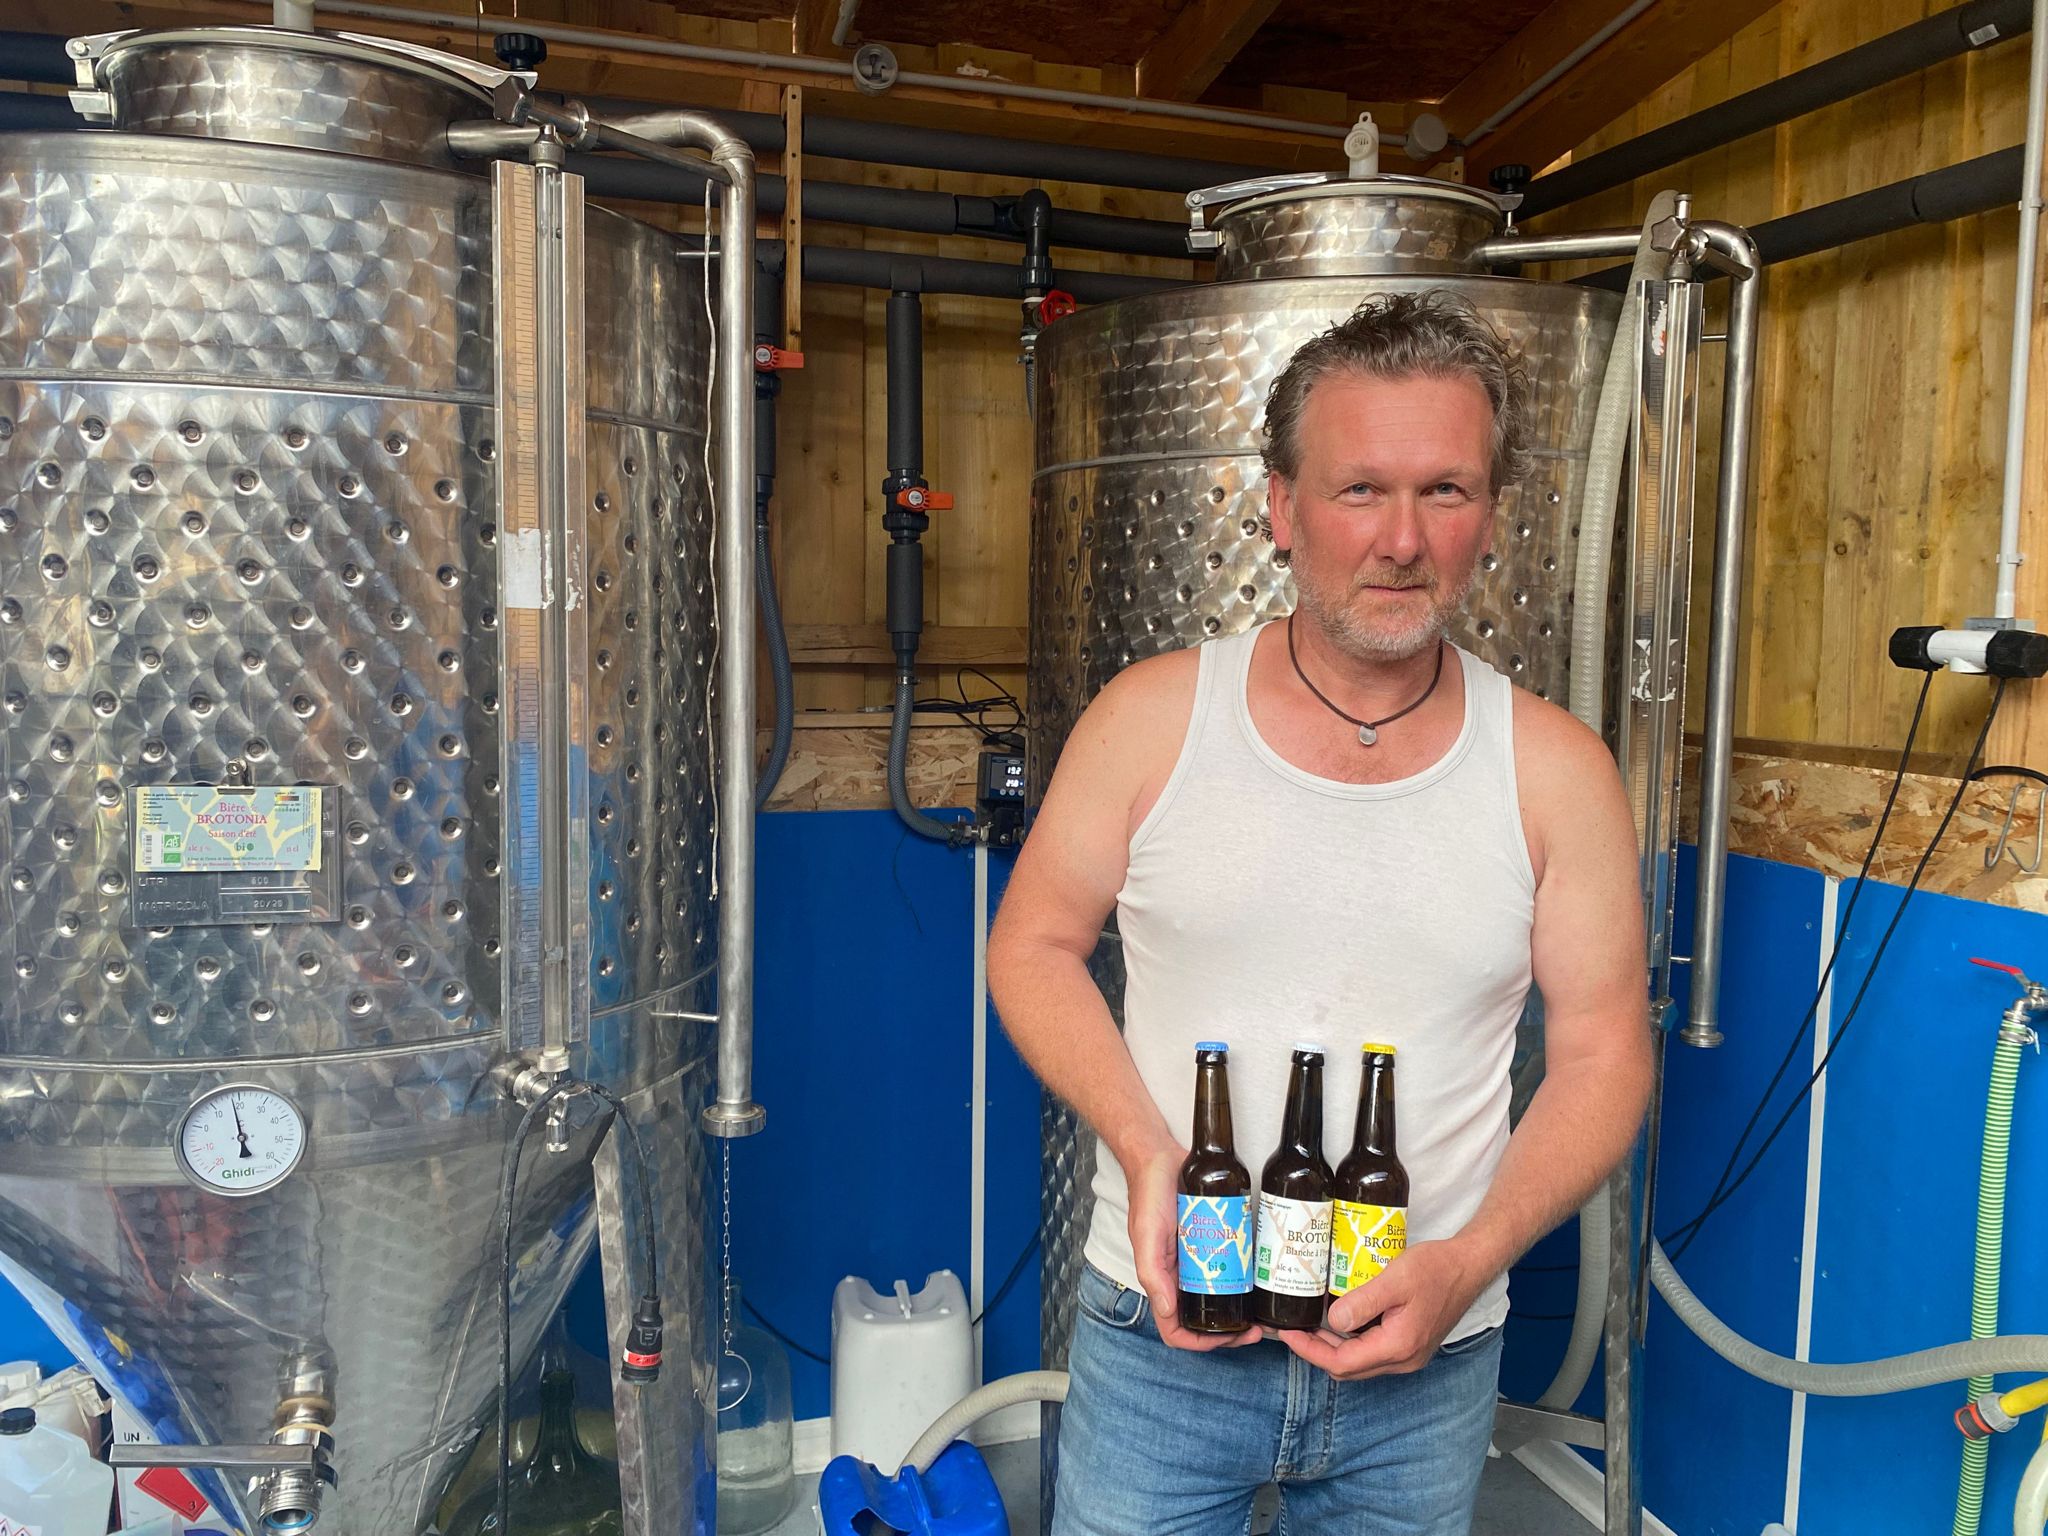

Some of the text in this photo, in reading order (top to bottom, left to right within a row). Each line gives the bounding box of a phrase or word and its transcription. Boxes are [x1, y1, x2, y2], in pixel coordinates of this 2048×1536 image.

[220, 802, 246, 812] Bière
[196, 814, 268, 825] BROTONIA
[208, 829, 236, 838] Saison
[140, 900, 209, 911] MATRICOLA
[222, 1167, 255, 1179] Ghidi
[1192, 1213, 1217, 1225] Bière
[1288, 1230, 1330, 1243] BROTO
[1203, 1245, 1230, 1257] Viking
[1286, 1246, 1314, 1257] Blanche
[124, 1432, 140, 1442] UN
[189, 1500, 196, 1510] 3
